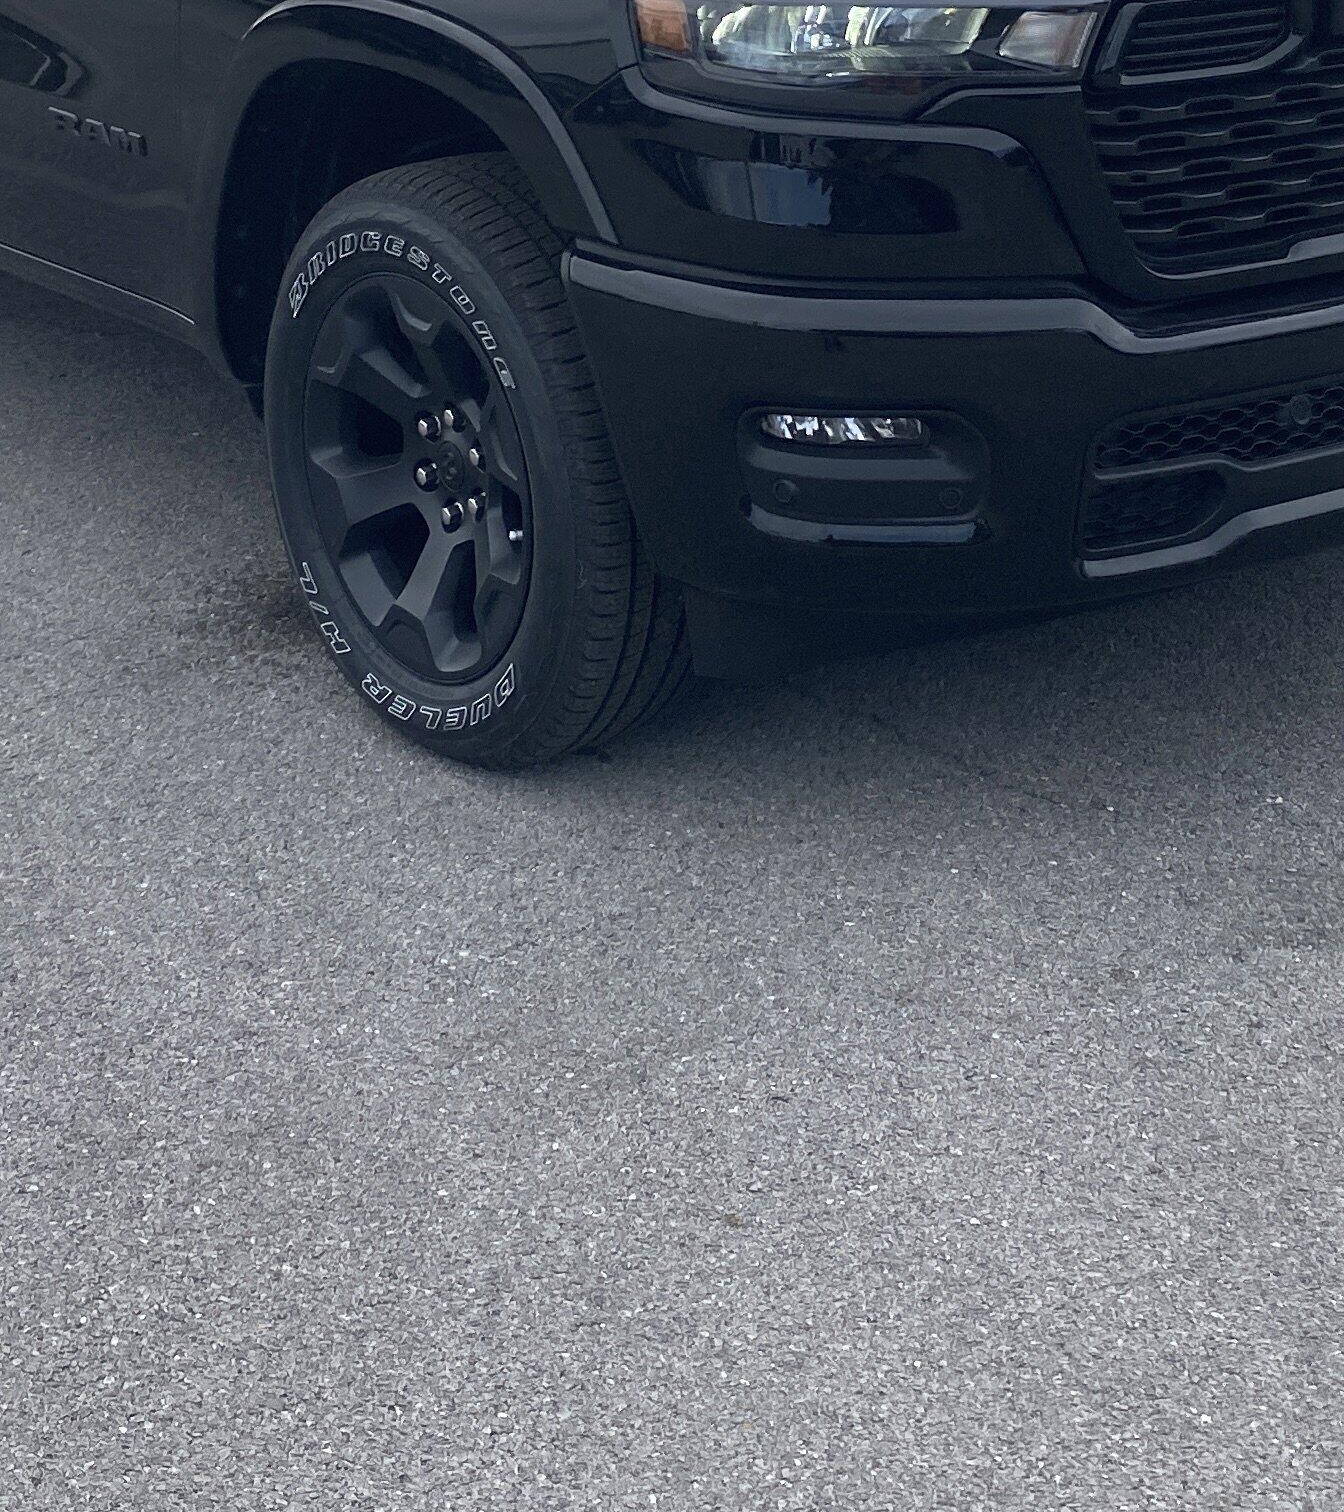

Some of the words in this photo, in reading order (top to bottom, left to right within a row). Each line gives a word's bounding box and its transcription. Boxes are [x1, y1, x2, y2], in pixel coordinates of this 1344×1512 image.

[47, 105, 148, 158] RAM
[287, 231, 516, 389] BRIDGESTONE
[361, 663, 516, 731] DUELER
